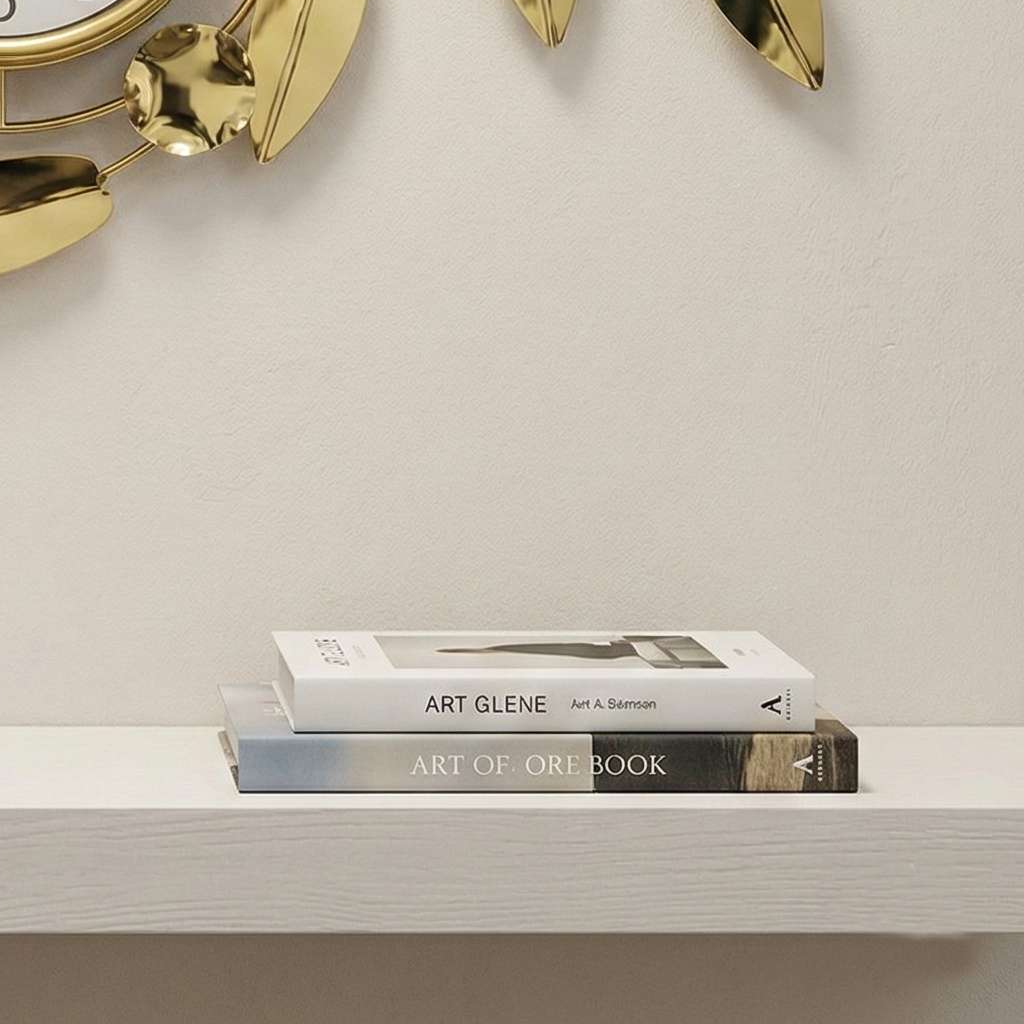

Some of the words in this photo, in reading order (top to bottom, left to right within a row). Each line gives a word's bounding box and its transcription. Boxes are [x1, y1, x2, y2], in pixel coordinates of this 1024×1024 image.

[425, 695, 468, 713] ART
[474, 694, 547, 714] GLENE
[410, 754, 465, 775] ART
[525, 754, 580, 776] ORE
[589, 754, 667, 776] BOOK
